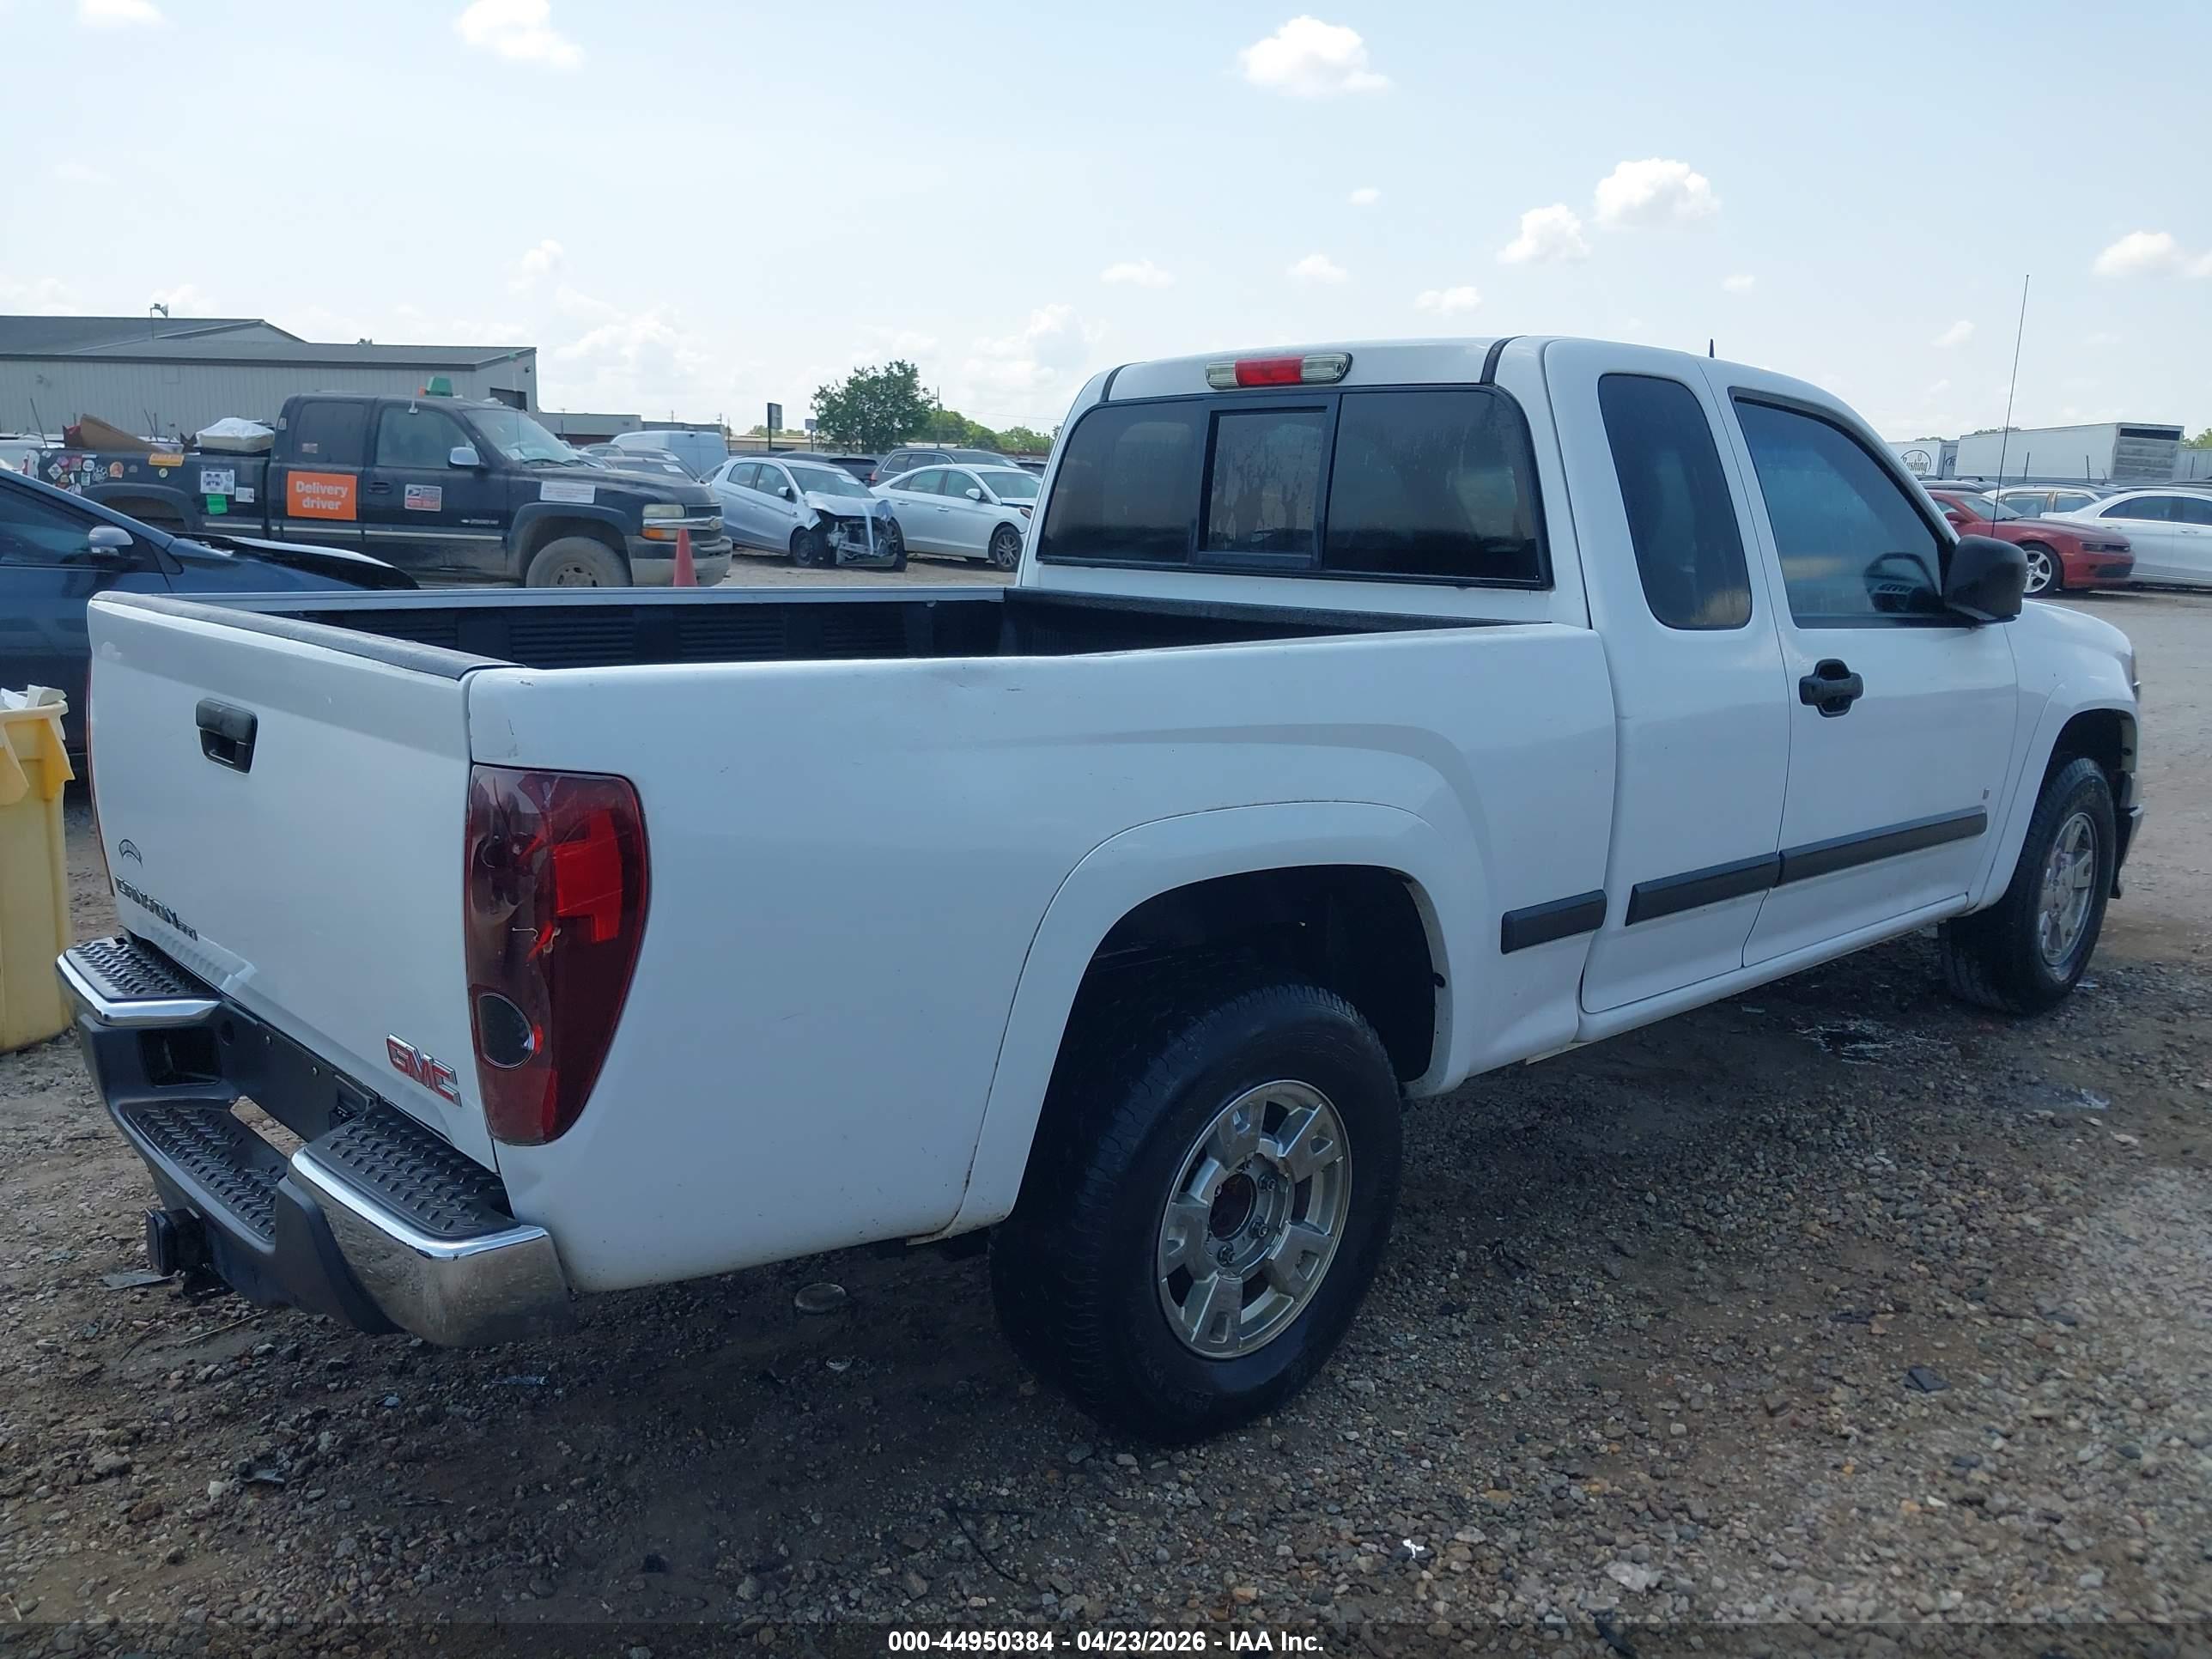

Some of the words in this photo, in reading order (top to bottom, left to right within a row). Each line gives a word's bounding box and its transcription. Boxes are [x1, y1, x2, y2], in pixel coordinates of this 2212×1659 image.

[295, 480, 349, 498] Delivery
[301, 496, 342, 510] driver
[386, 1032, 463, 1108] GMC
